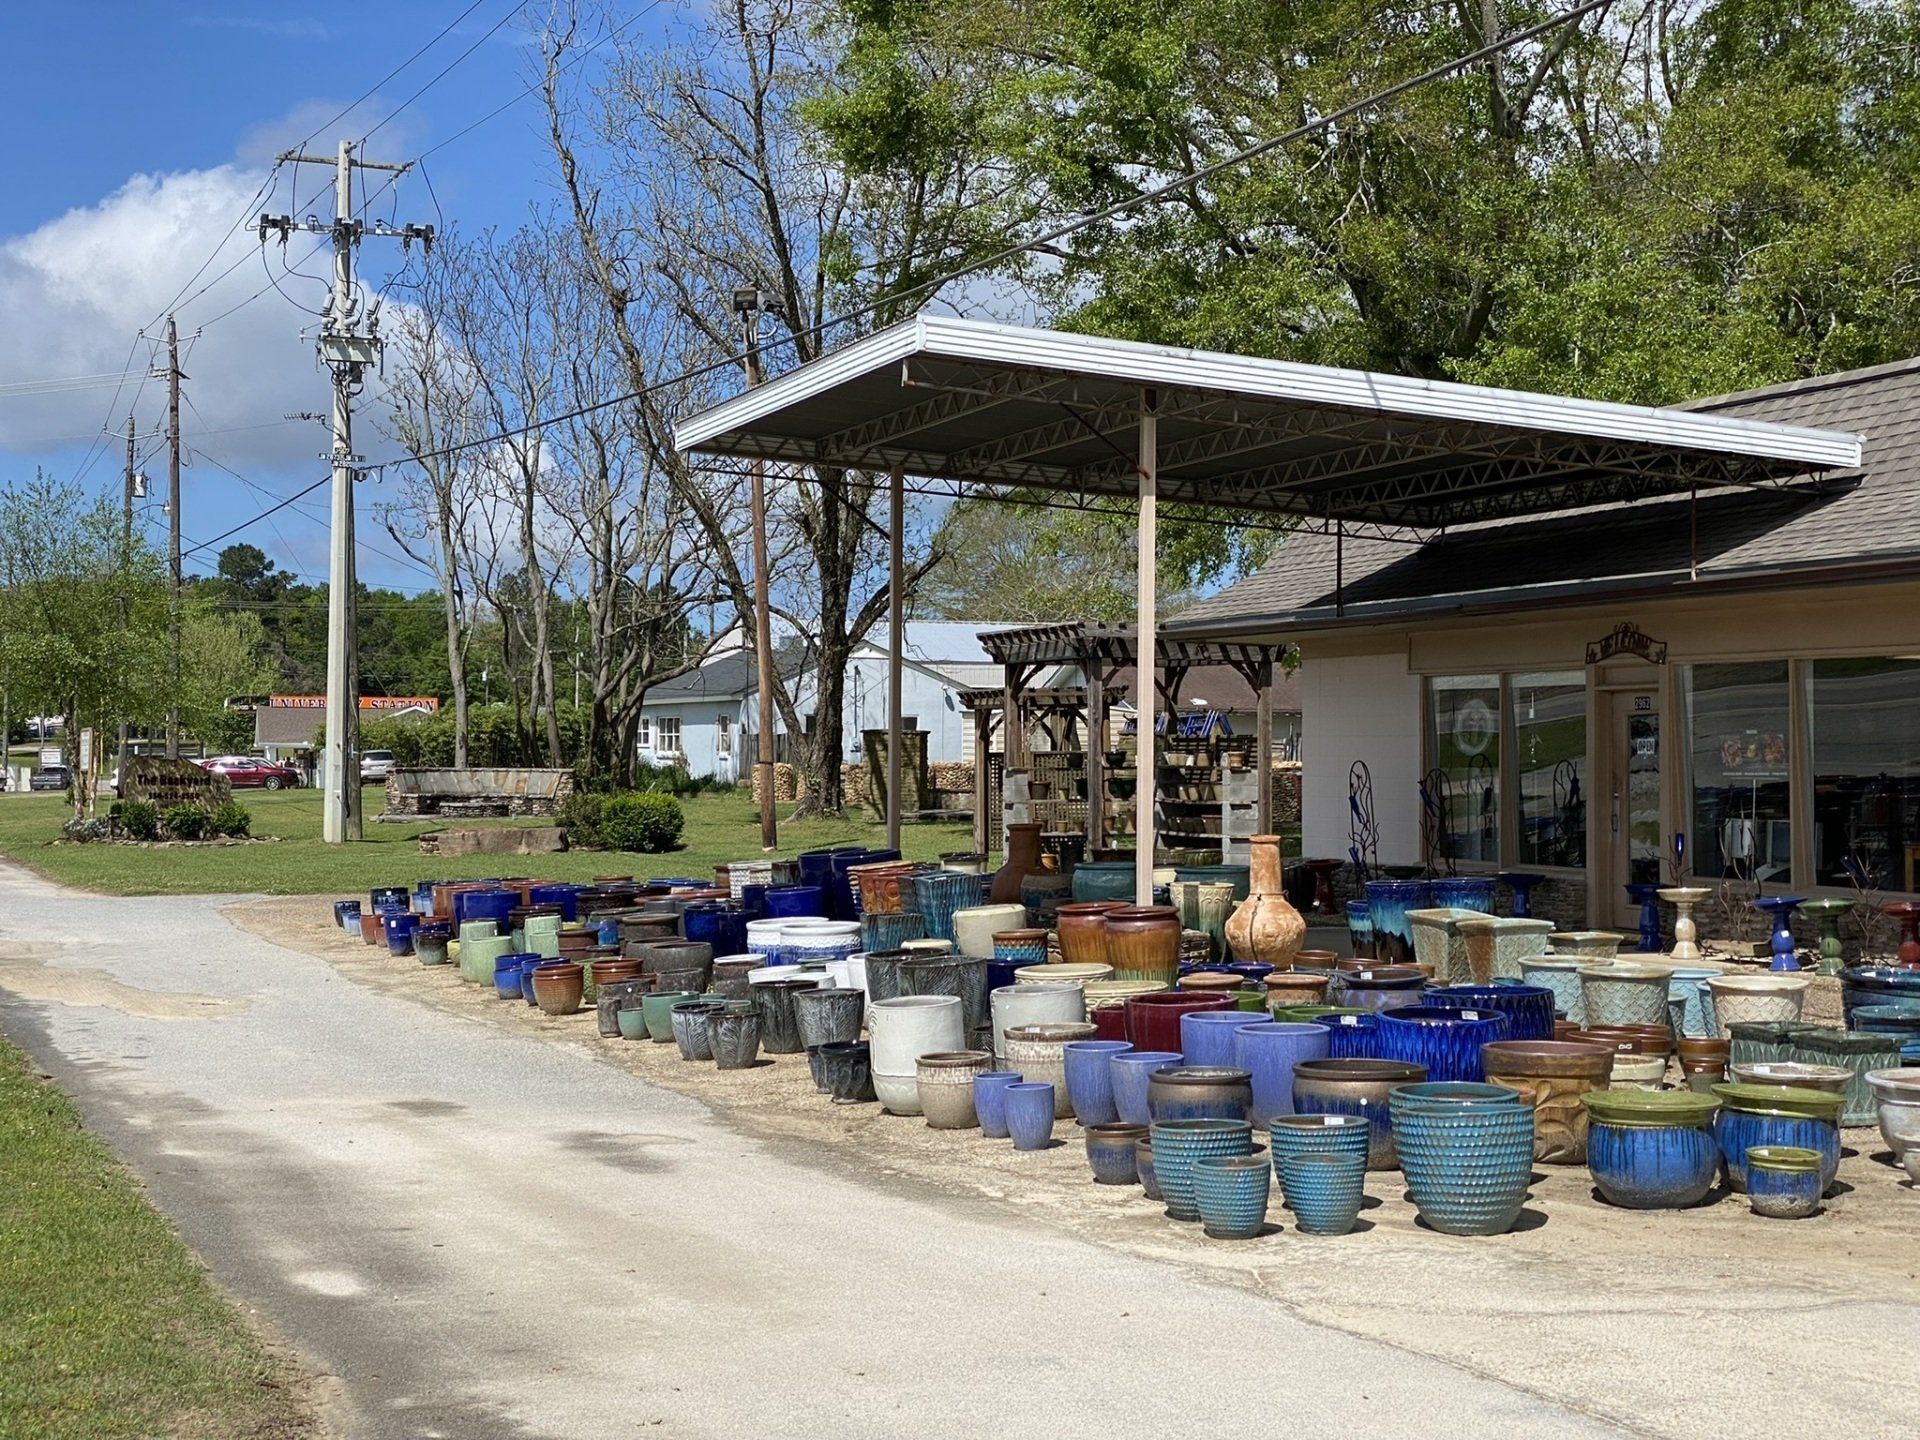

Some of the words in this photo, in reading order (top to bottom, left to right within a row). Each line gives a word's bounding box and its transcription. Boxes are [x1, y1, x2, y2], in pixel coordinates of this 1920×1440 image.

[1638, 740, 1654, 752] OPEN
[137, 774, 157, 786] The
[160, 774, 211, 787] Backyard
